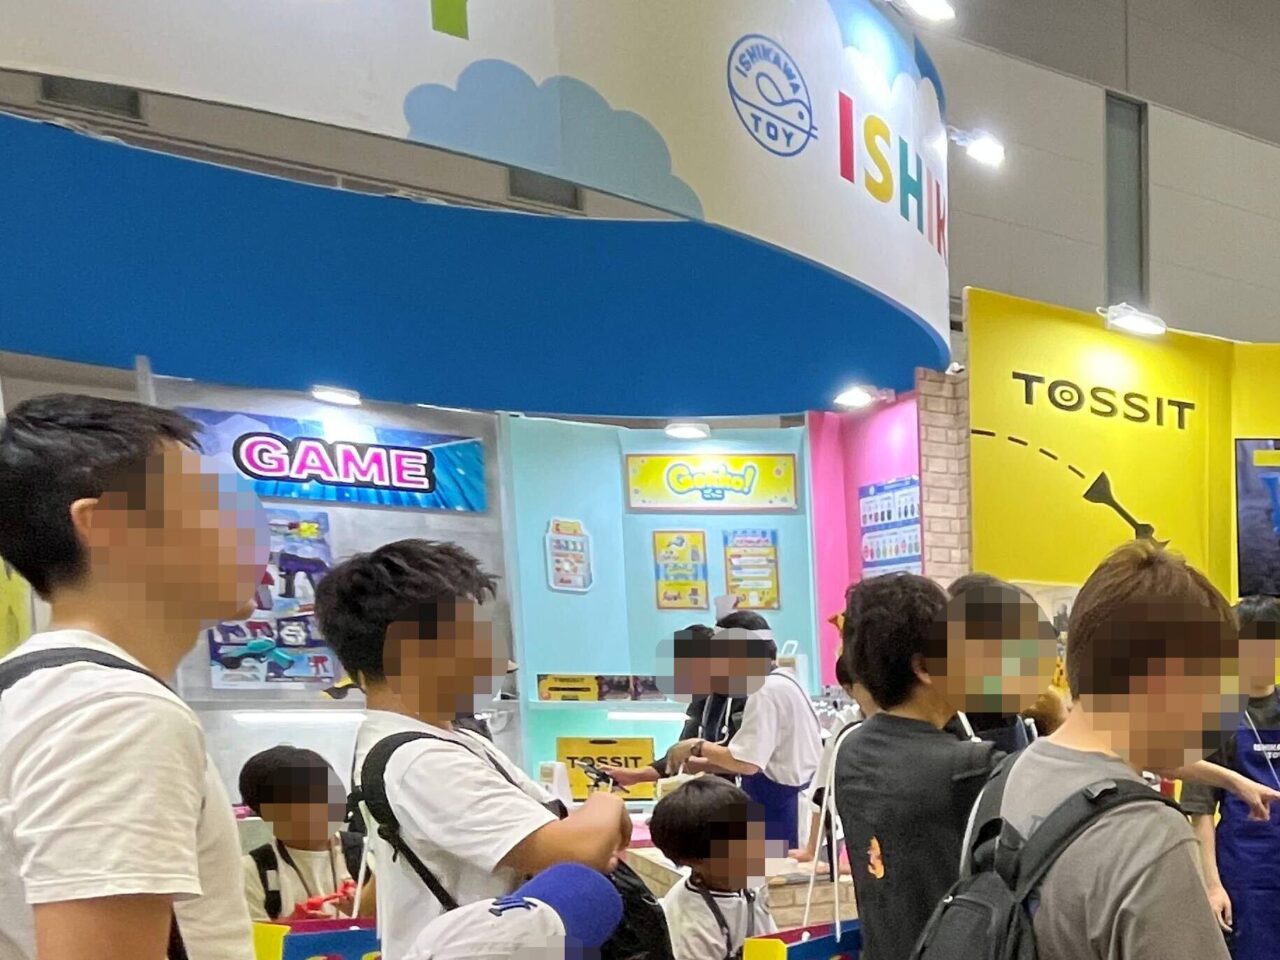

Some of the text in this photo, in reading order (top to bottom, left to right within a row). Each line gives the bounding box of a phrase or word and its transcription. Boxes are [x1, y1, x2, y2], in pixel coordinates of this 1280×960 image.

[735, 43, 801, 95] ISHIKAWA
[751, 113, 795, 147] TOY
[1012, 371, 1195, 430] TOSSIT
[238, 435, 430, 490] GAME
